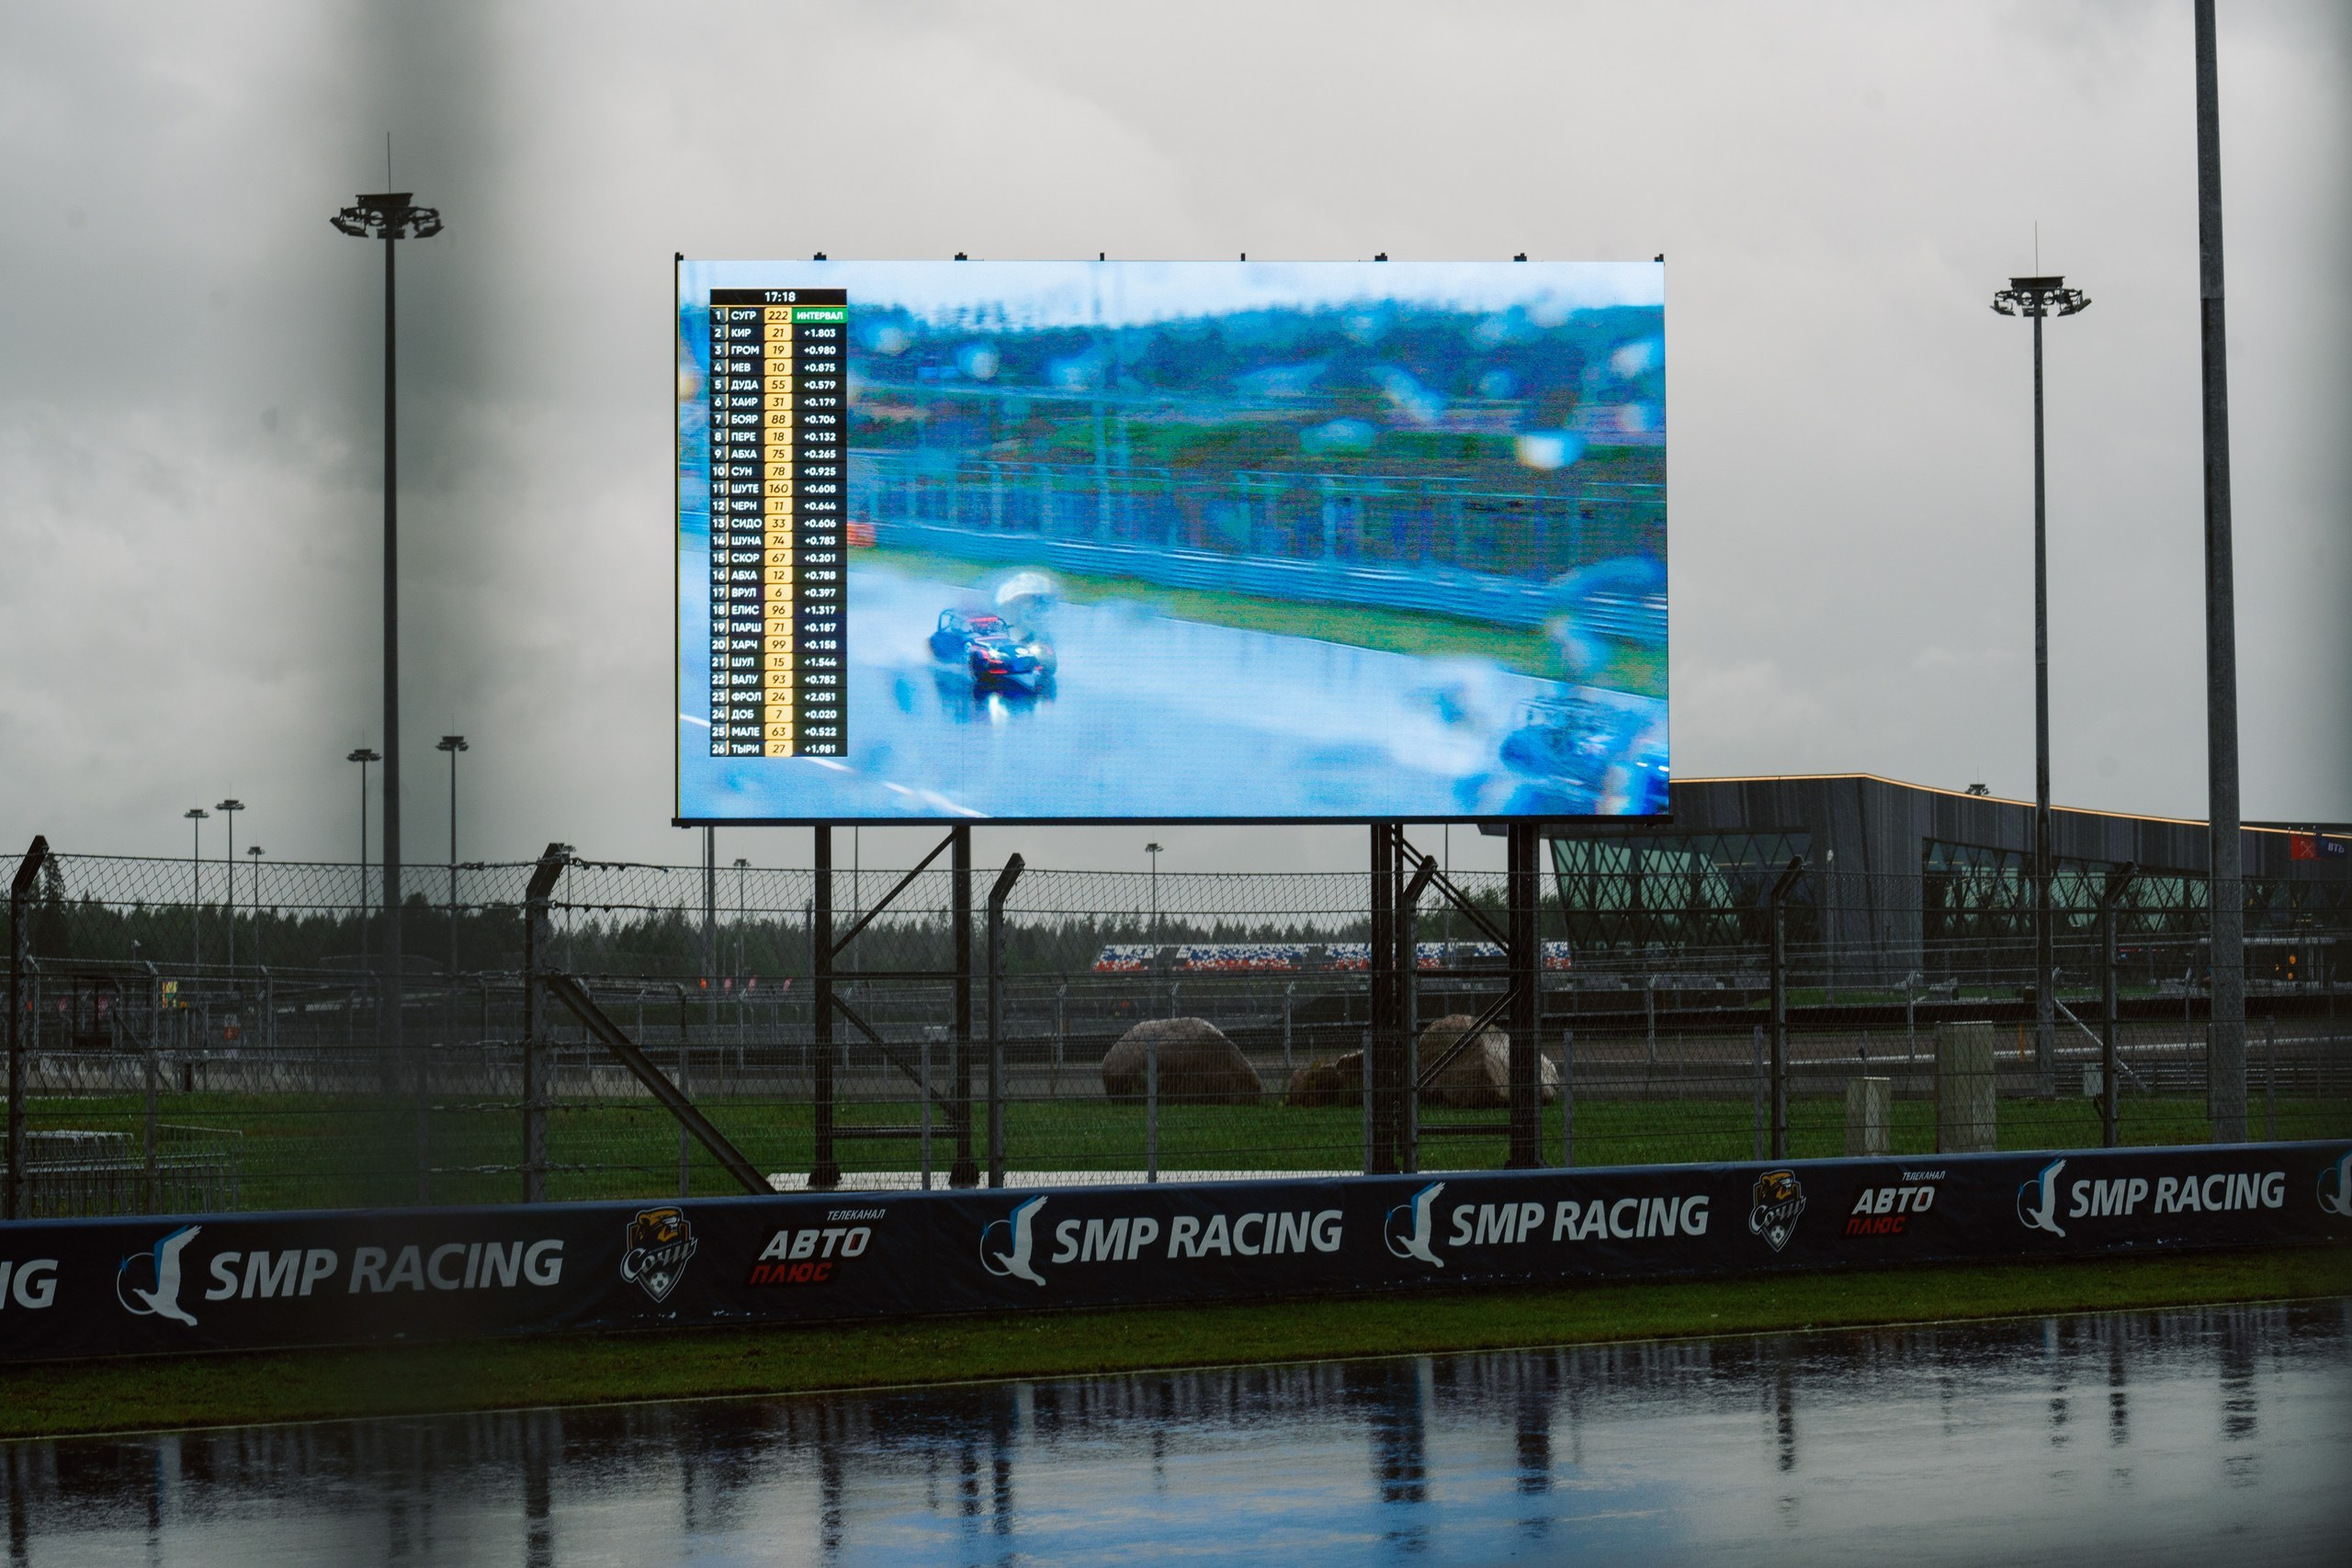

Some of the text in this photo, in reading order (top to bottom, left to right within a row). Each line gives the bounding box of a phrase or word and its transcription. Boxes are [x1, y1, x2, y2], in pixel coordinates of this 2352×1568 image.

[764, 291, 797, 302] 17:18
[730, 311, 757, 321] СУГР
[767, 311, 788, 321] 222
[797, 311, 843, 321] ИНТЕРВАЛ
[730, 329, 752, 338] КИР
[772, 329, 784, 338] 21
[730, 346, 760, 355] ГРОМ
[773, 346, 785, 355] 19
[730, 363, 752, 372] ИЕВ
[773, 363, 786, 372] 10
[730, 380, 759, 390] ДУДА
[771, 380, 786, 389] 55
[730, 398, 759, 407] ХАИР
[773, 398, 785, 407] 31
[730, 415, 759, 424] БОЯР
[771, 415, 786, 424] 88
[730, 433, 756, 442] ПЕРЕ
[774, 433, 785, 442] 18
[730, 450, 758, 459] АБХА
[773, 450, 785, 459] 75
[712, 467, 726, 477] 10
[730, 467, 752, 476] СУН
[773, 467, 786, 476] 78
[712, 484, 724, 493] 11
[730, 484, 759, 493] ШУТЕ
[769, 484, 789, 493] 160
[712, 502, 725, 511] 12
[730, 502, 757, 511] ЧЕРН
[775, 502, 784, 511] 11
[712, 519, 726, 528] 13
[730, 519, 763, 528] СИДО
[772, 520, 786, 528] 33
[712, 536, 726, 546] 14
[730, 536, 762, 546] ШУНА
[773, 536, 785, 545] 74
[713, 554, 726, 563] 15
[730, 553, 760, 562] СКОР
[772, 554, 786, 563] 67
[712, 570, 726, 581] 16
[730, 570, 758, 580] АБХА
[774, 571, 785, 580] 12
[712, 588, 725, 597] 17
[730, 588, 757, 597] ВРУЛ
[712, 605, 726, 615] 18
[730, 605, 760, 615] ЕЛИС
[772, 606, 786, 615] 96
[712, 623, 726, 633] 19
[730, 623, 763, 632] ПАРШ
[774, 624, 785, 632] 71
[712, 640, 726, 650] 20
[730, 640, 758, 649] ХАРЧ
[772, 641, 786, 649] 99
[712, 658, 725, 667] 21
[730, 658, 754, 667] ШУЛ
[774, 659, 785, 667] 15
[711, 675, 725, 685] 22
[730, 675, 759, 684] ВАЛУ
[773, 675, 786, 684] 93
[712, 693, 726, 702] 23
[730, 692, 763, 701] ФРОЛ
[772, 693, 786, 702] 24
[712, 710, 726, 719] 24
[730, 710, 754, 720] ДОБ
[712, 728, 726, 737] 25
[730, 728, 761, 737] МАЛЕ
[772, 728, 786, 737] 63
[712, 744, 726, 754] 26
[730, 745, 760, 754] ТЫРИ
[773, 745, 786, 753] 27
[1902, 1170, 1946, 1181] ТЕЛЕКАНАЛ
[2069, 1171, 2286, 1218] SMP RACING
[1851, 1186, 1936, 1215] АВТО
[827, 1208, 887, 1221] ТЕЛЕКАНАЛ
[1448, 1195, 1710, 1247] SMP RACING
[1845, 1216, 1906, 1235] ПЛЮС
[1051, 1210, 1343, 1263] SMP RACING
[758, 1226, 872, 1261] АВТО
[204, 1239, 565, 1301] SMP RACING
[750, 1261, 833, 1285] ПЛЮС
